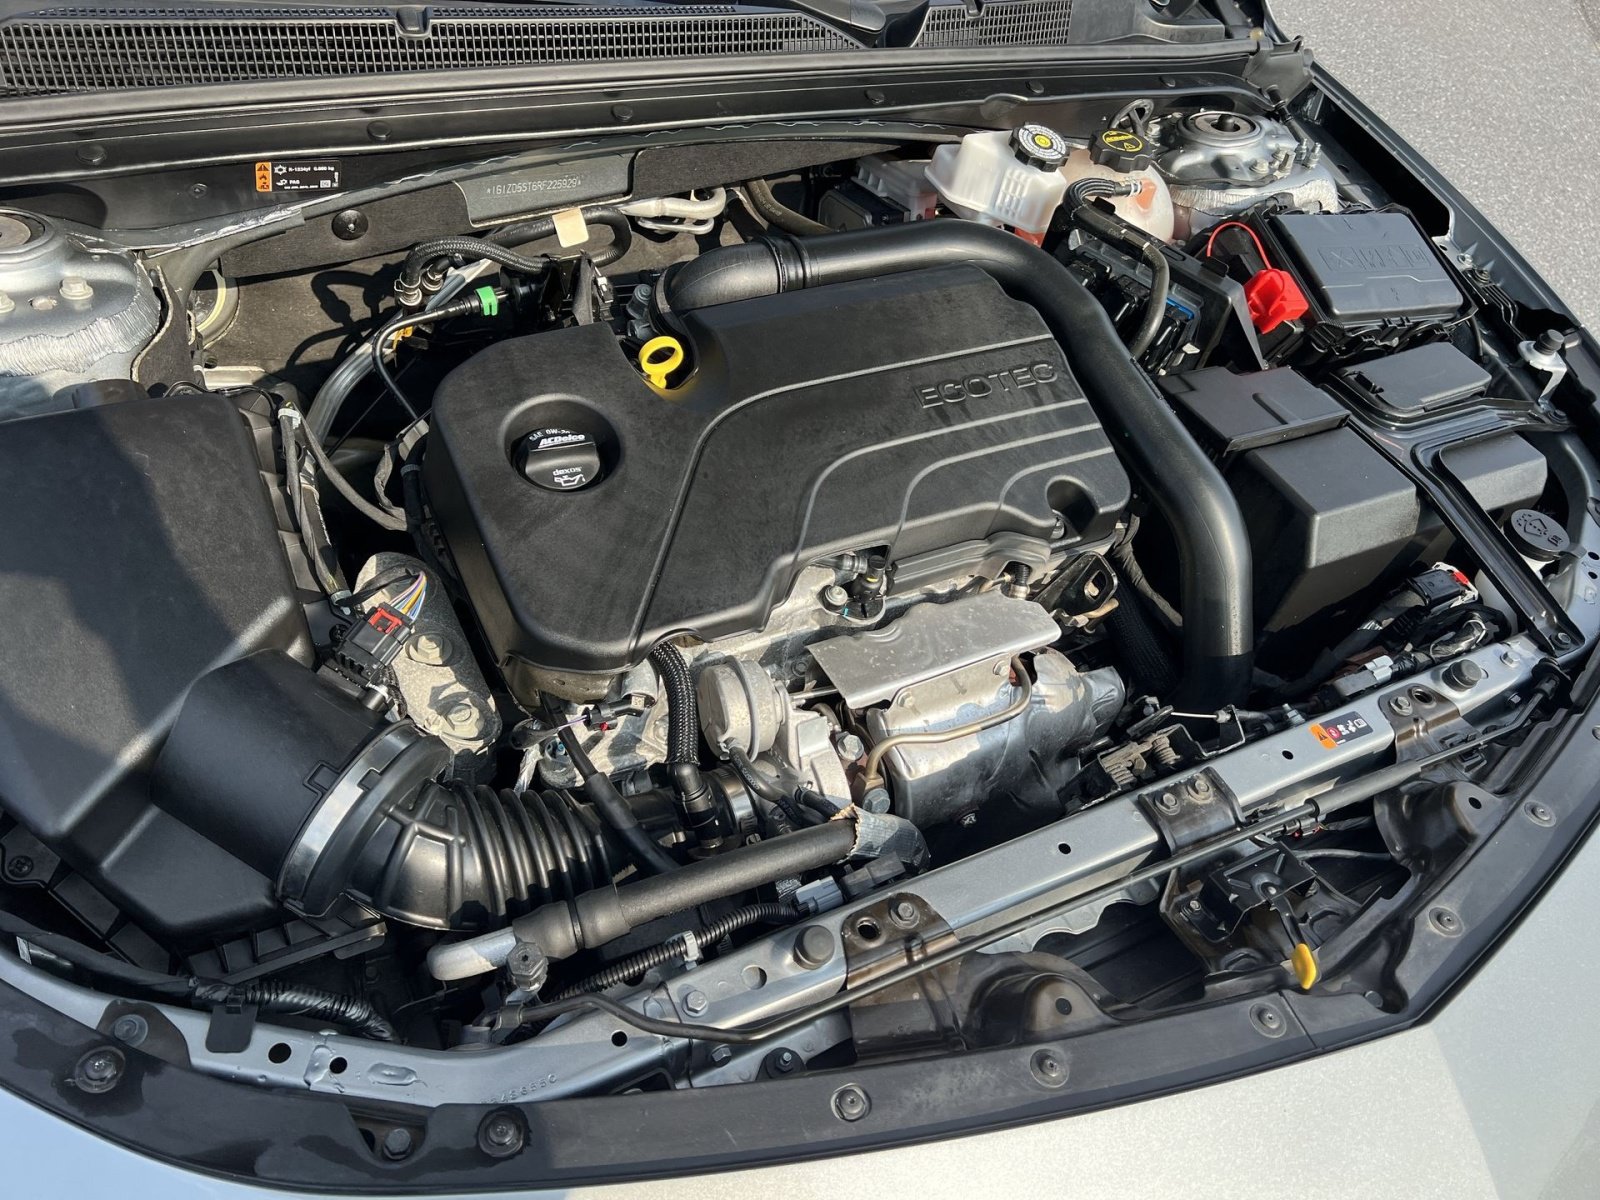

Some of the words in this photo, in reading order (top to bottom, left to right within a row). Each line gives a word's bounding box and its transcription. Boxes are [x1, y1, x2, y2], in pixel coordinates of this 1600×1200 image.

[913, 363, 1058, 408] ECOTEC
[529, 431, 544, 441] SAE
[538, 434, 586, 448] ACDelco
[552, 466, 582, 476] dexos
